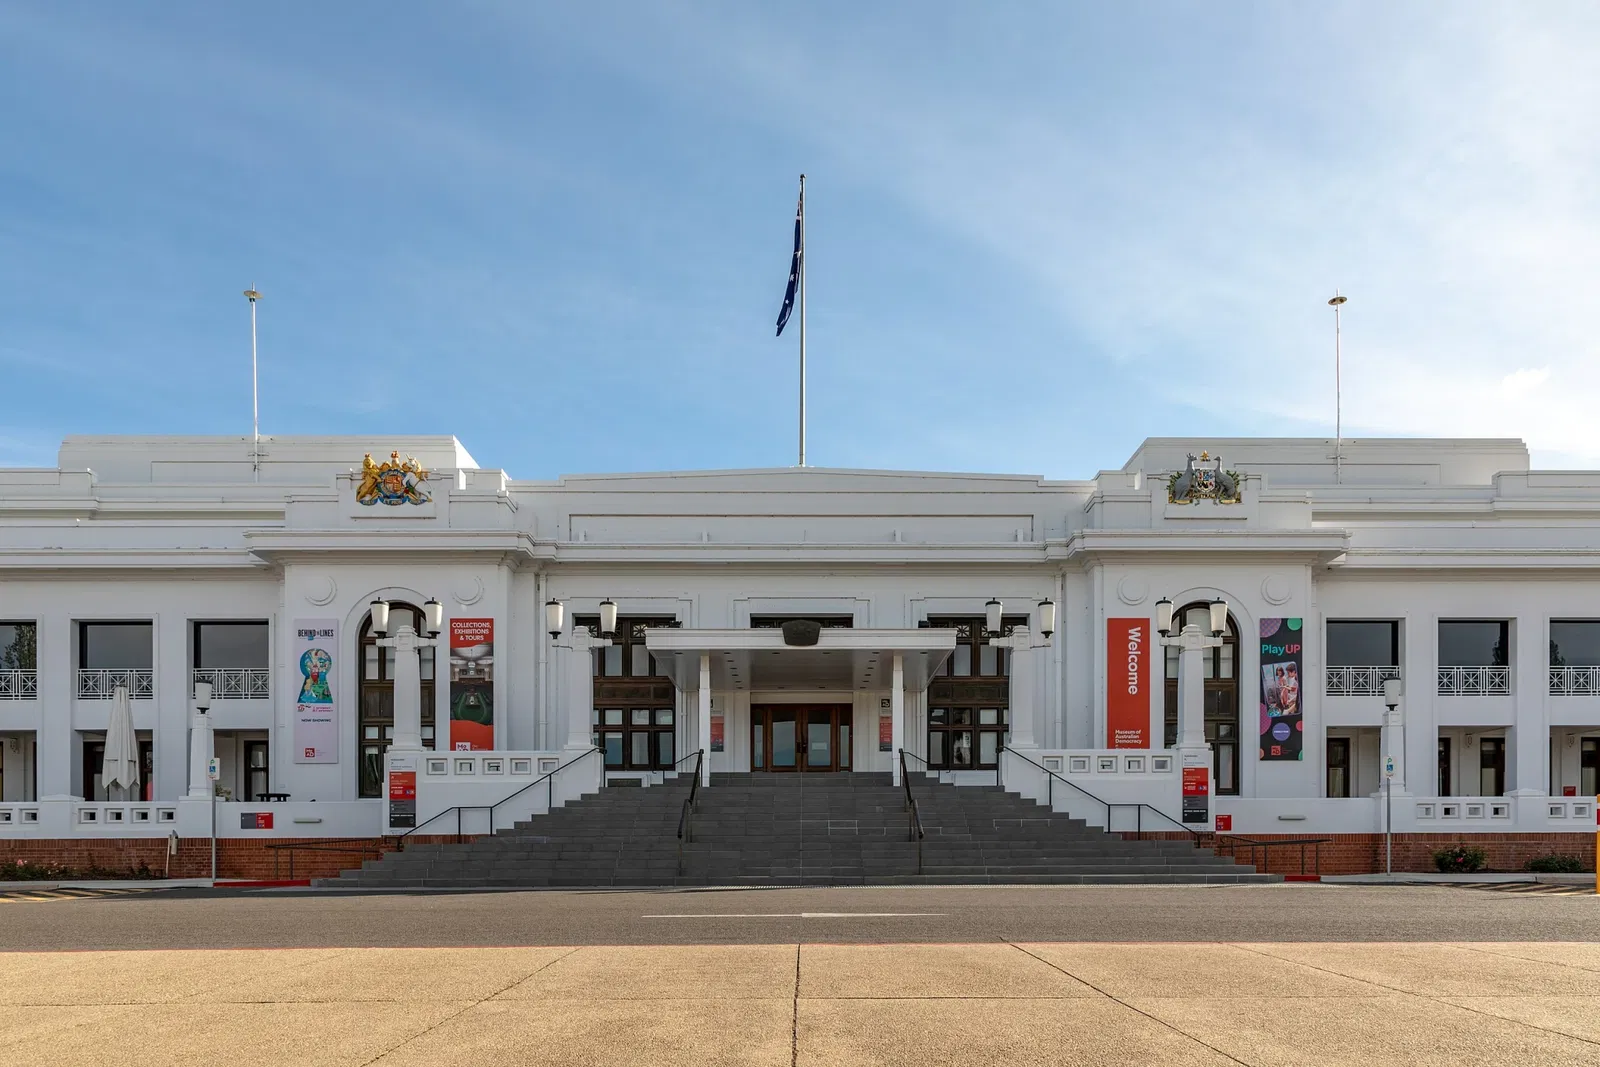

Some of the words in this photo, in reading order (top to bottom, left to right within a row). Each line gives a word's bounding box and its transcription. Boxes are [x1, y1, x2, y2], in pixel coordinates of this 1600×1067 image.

[298, 629, 316, 637] BEHIND
[320, 629, 334, 637] LINES
[1128, 627, 1141, 695] Welcome
